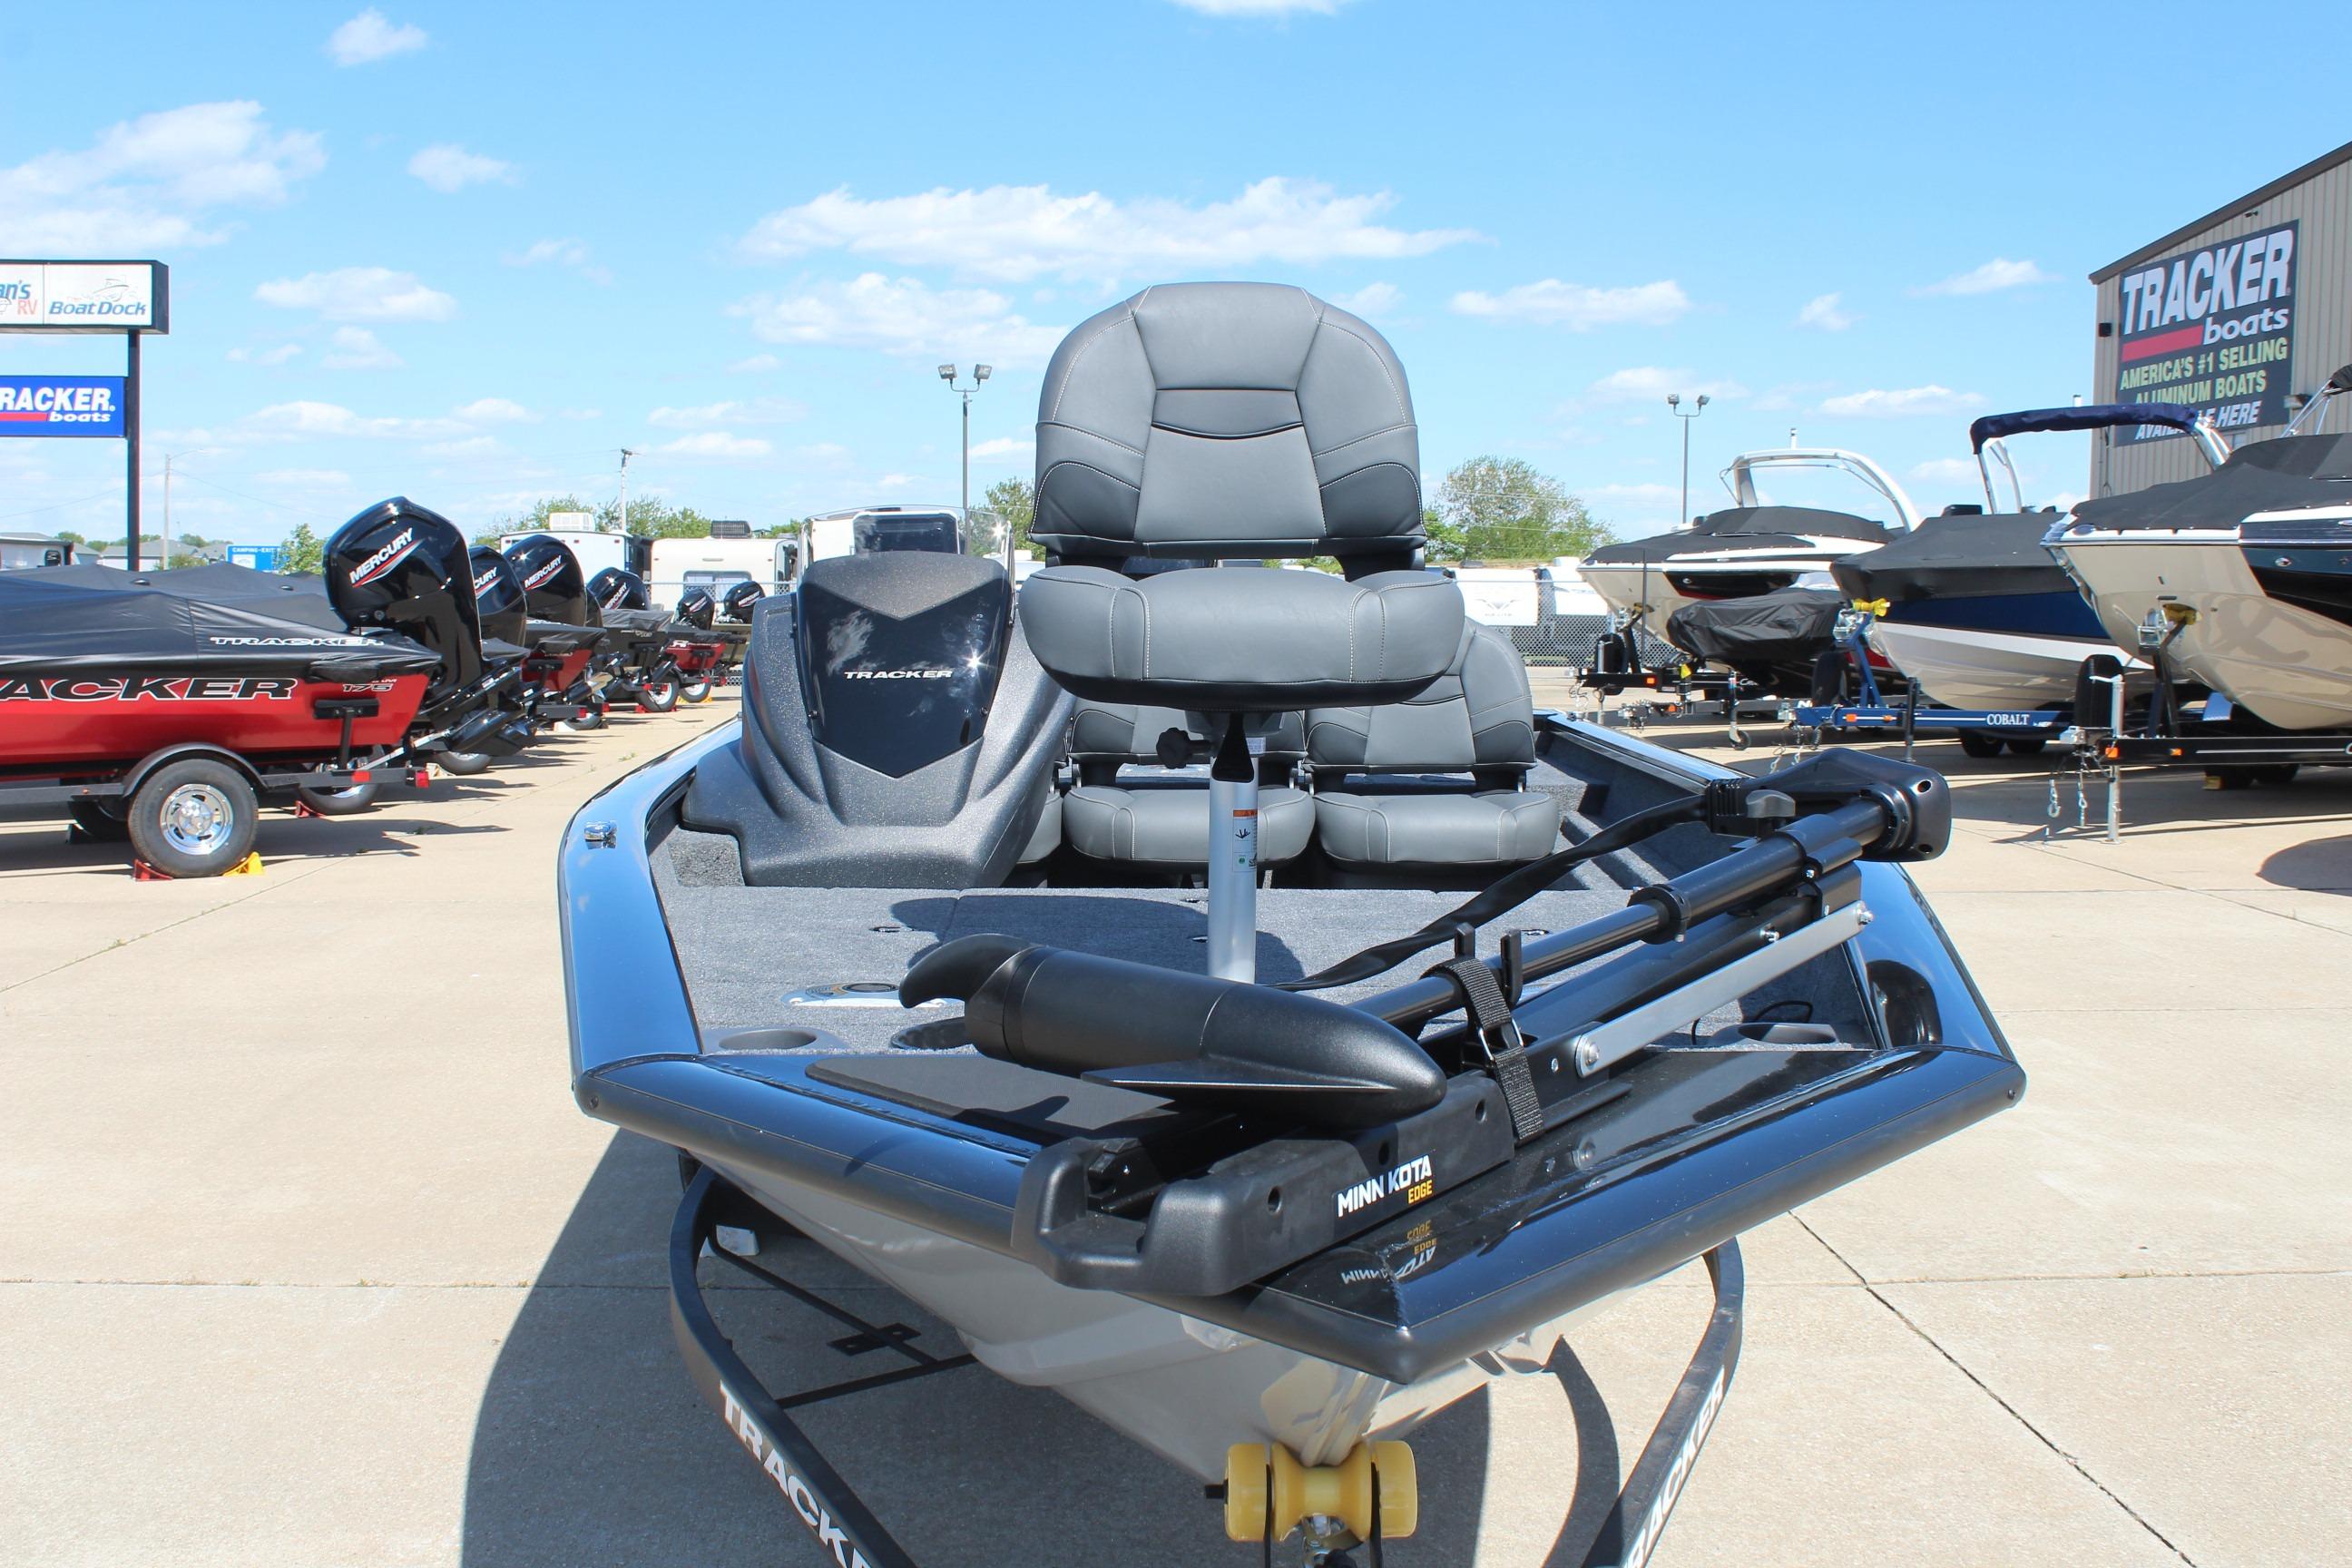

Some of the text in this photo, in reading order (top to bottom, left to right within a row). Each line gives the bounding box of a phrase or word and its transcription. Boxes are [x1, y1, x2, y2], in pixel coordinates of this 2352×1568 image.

[2123, 230, 2294, 335] TRACKER
[16, 300, 37, 315] RV
[2203, 307, 2289, 346] boats
[2120, 337, 2288, 391] AMERICA'S #1 SELLING
[2135, 370, 2267, 406] ALUMINUM BOATS
[49, 411, 111, 422] boats
[2216, 400, 2262, 428] HERE
[349, 527, 413, 583] MERCURY
[524, 555, 562, 588] MERCURY
[343, 683, 394, 692] 175
[844, 670, 953, 680] TRACKER
[1986, 713, 2030, 725] COBALT
[1338, 1155, 1432, 1218] MINN KOTA
[1408, 1180, 1433, 1204] EDGE
